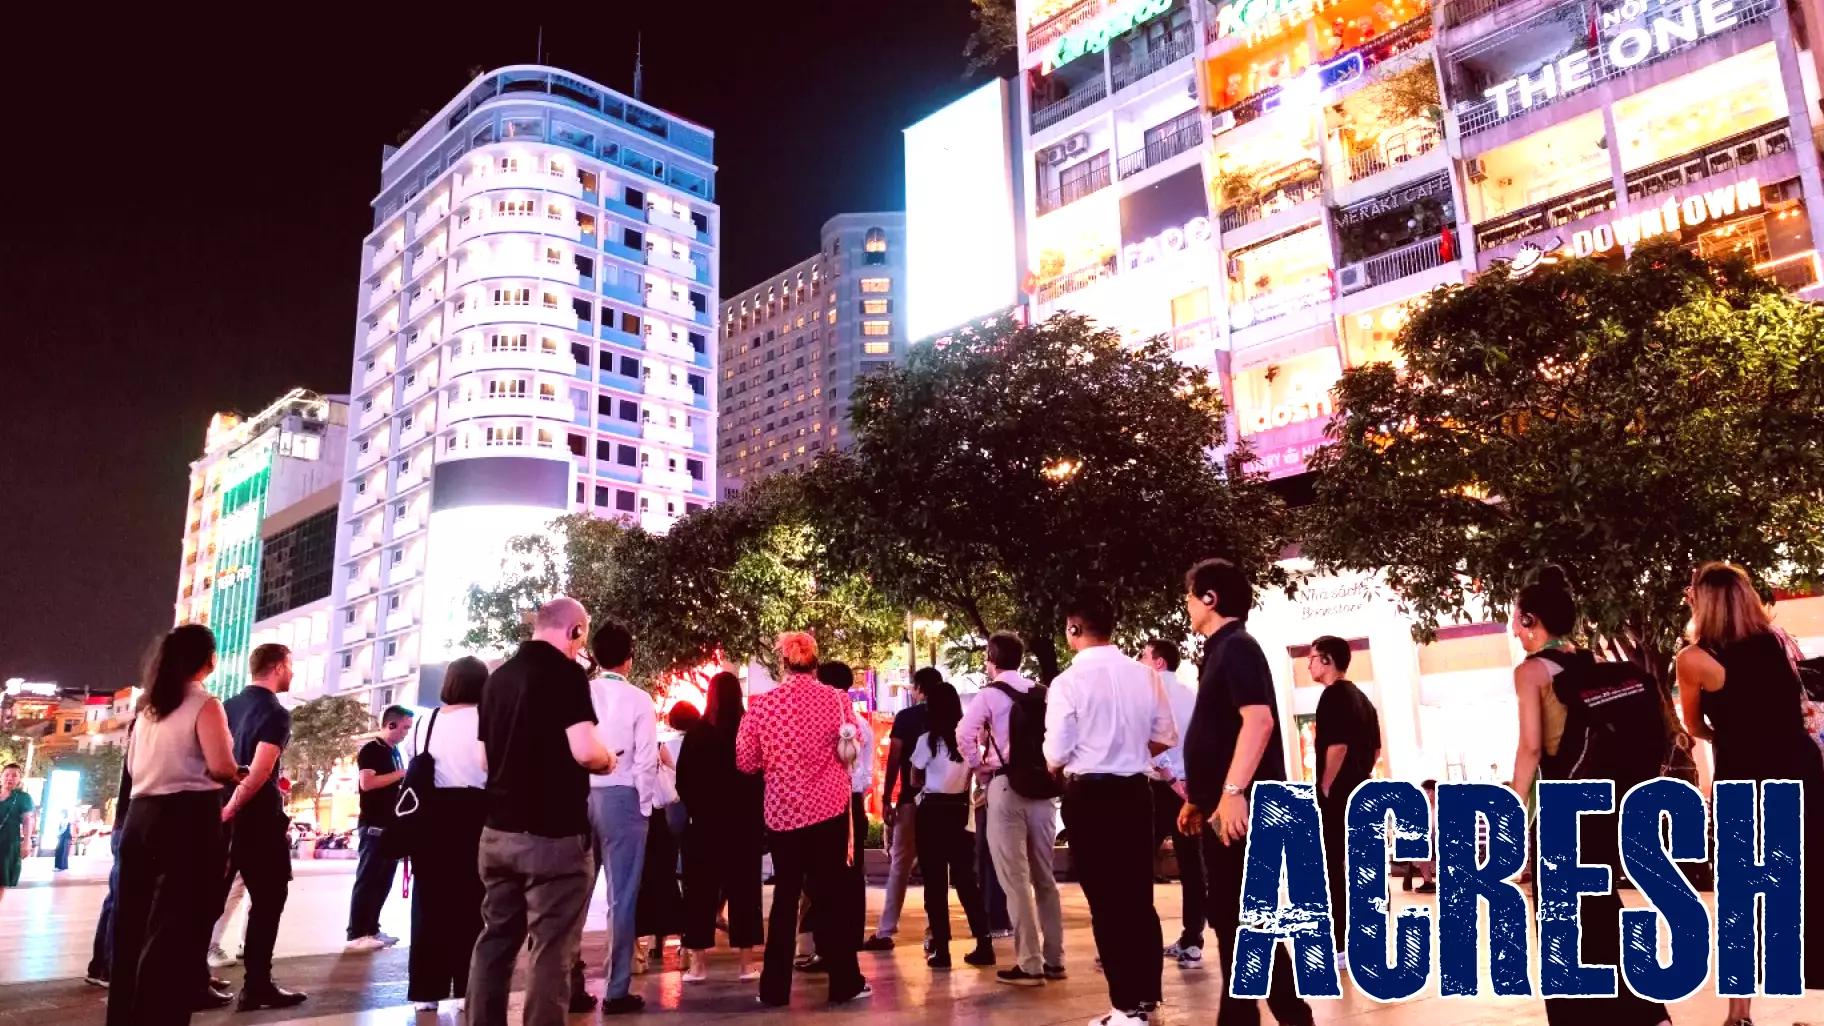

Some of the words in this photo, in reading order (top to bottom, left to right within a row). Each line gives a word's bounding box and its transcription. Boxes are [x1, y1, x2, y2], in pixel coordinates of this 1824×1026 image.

[1485, 49, 1593, 118] THE
[1609, 0, 1738, 68] ONE
[1334, 191, 1401, 230] MERAKI
